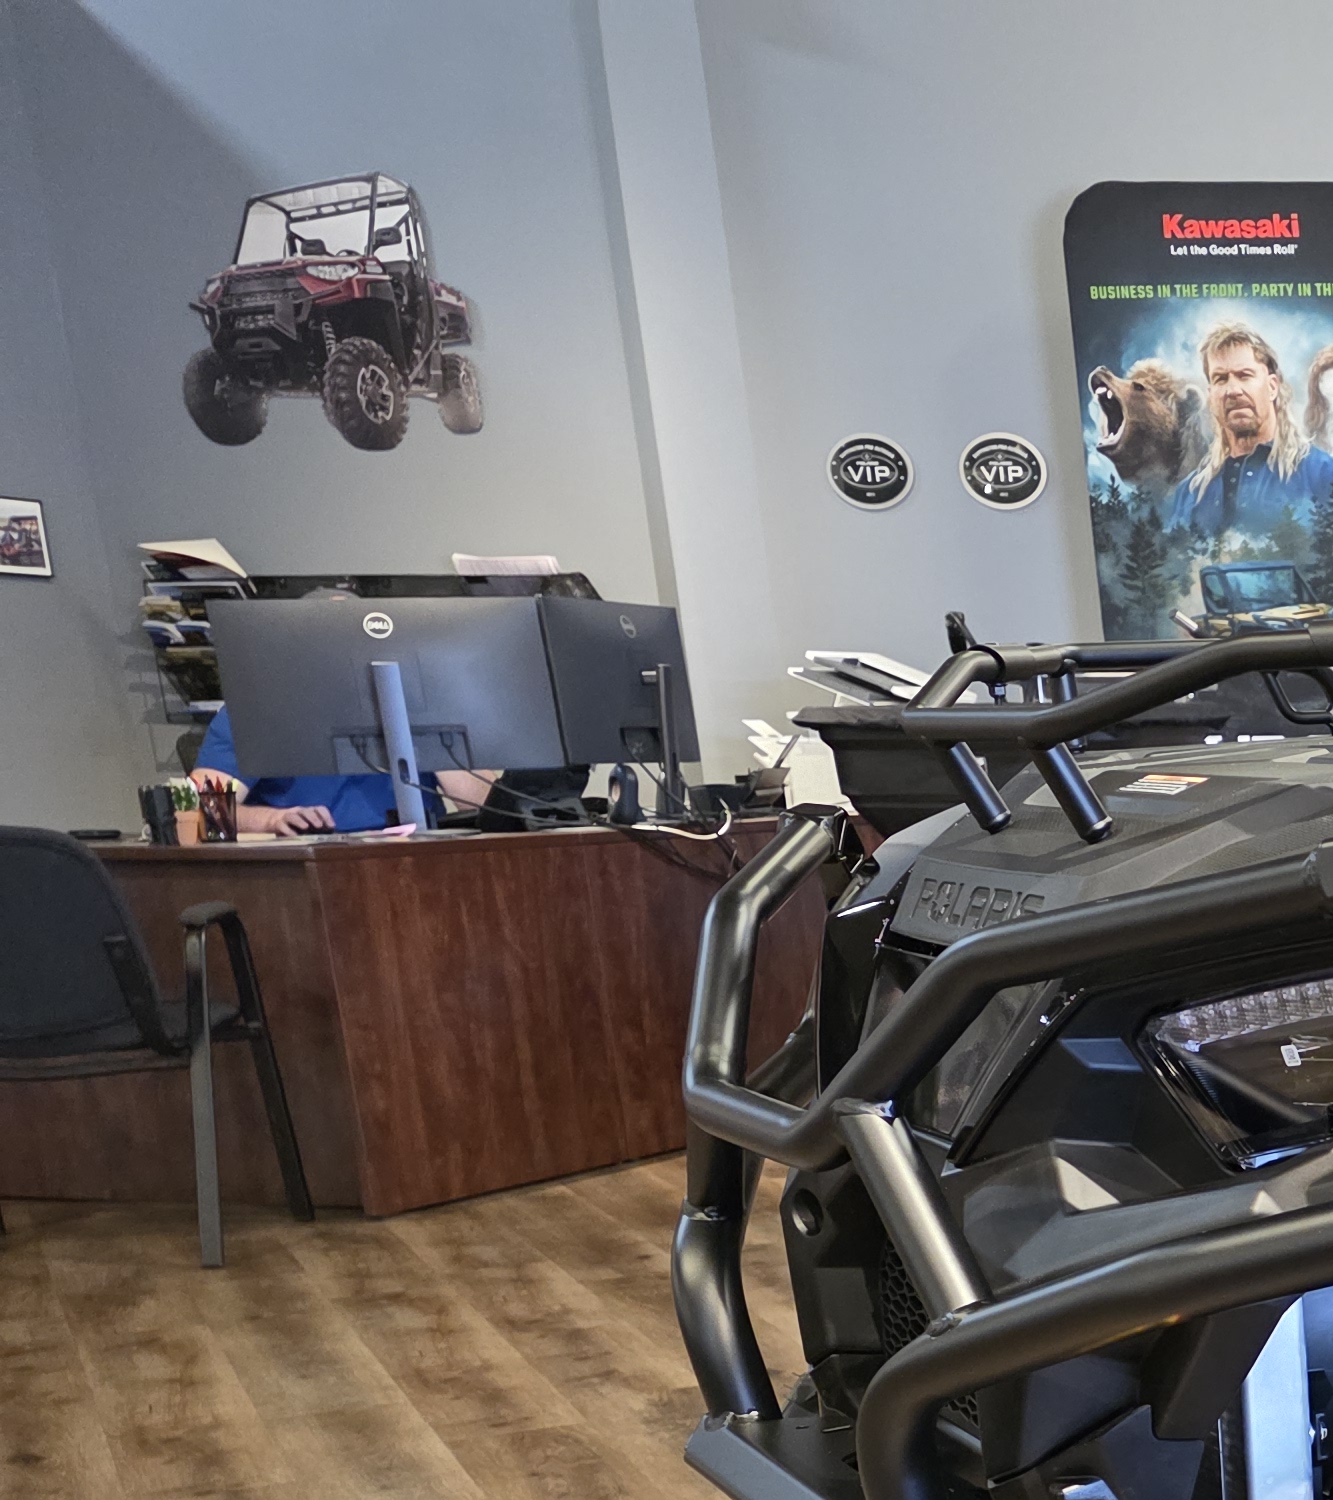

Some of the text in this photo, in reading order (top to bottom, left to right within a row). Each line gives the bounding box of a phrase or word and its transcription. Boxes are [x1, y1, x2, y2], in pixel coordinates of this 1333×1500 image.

[1162, 213, 1300, 239] Kawasaki
[1170, 244, 1187, 255] Let
[1190, 244, 1207, 255] the
[1209, 244, 1238, 256] Good
[1239, 244, 1272, 255] Times
[1090, 285, 1153, 299] BUSINESS
[1157, 284, 1171, 298] IN
[1174, 283, 1199, 298] THE
[1202, 283, 1248, 298] FRONT.
[1252, 283, 1293, 297] PARTY
[1298, 282, 1312, 297] IN
[847, 465, 890, 483] VIP
[980, 465, 1023, 483] VIP
